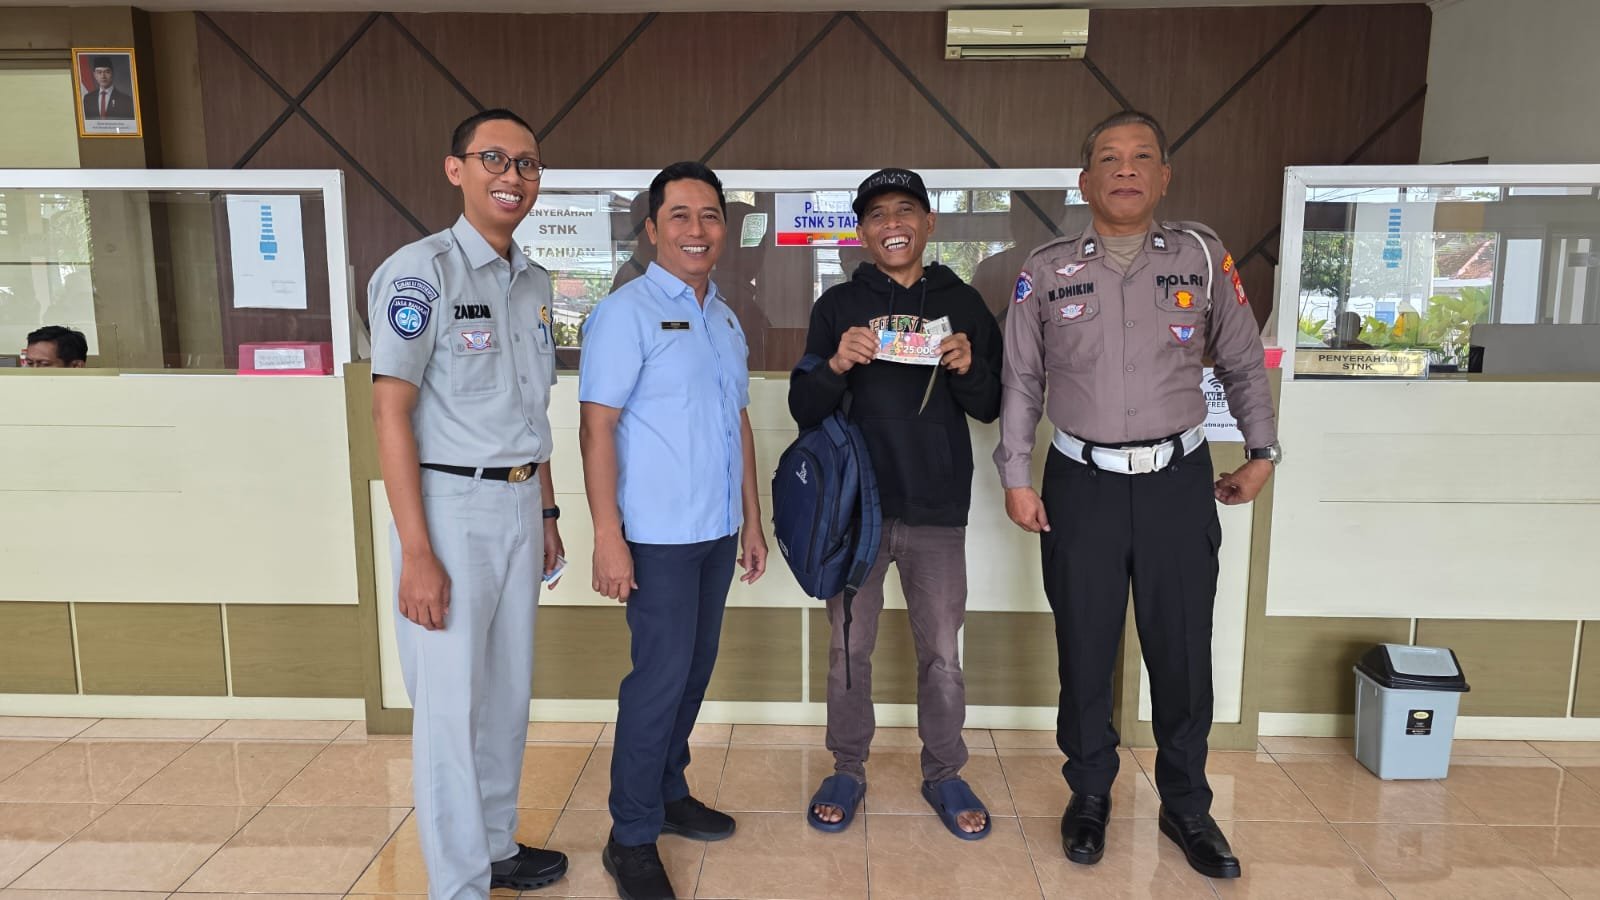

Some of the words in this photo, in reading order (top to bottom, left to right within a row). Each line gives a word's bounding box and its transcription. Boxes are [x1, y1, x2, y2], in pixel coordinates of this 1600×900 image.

[529, 208, 593, 217] ENYERAHAN
[794, 216, 824, 228] STNK
[828, 216, 835, 228] 5
[837, 216, 859, 228] TAH
[539, 224, 578, 235] STNK
[523, 245, 532, 257] 5
[536, 247, 596, 258] TAHUAN
[1156, 274, 1203, 287] POLRI
[1318, 354, 1398, 363] PENYERAHAN
[1342, 363, 1373, 371] STNK
